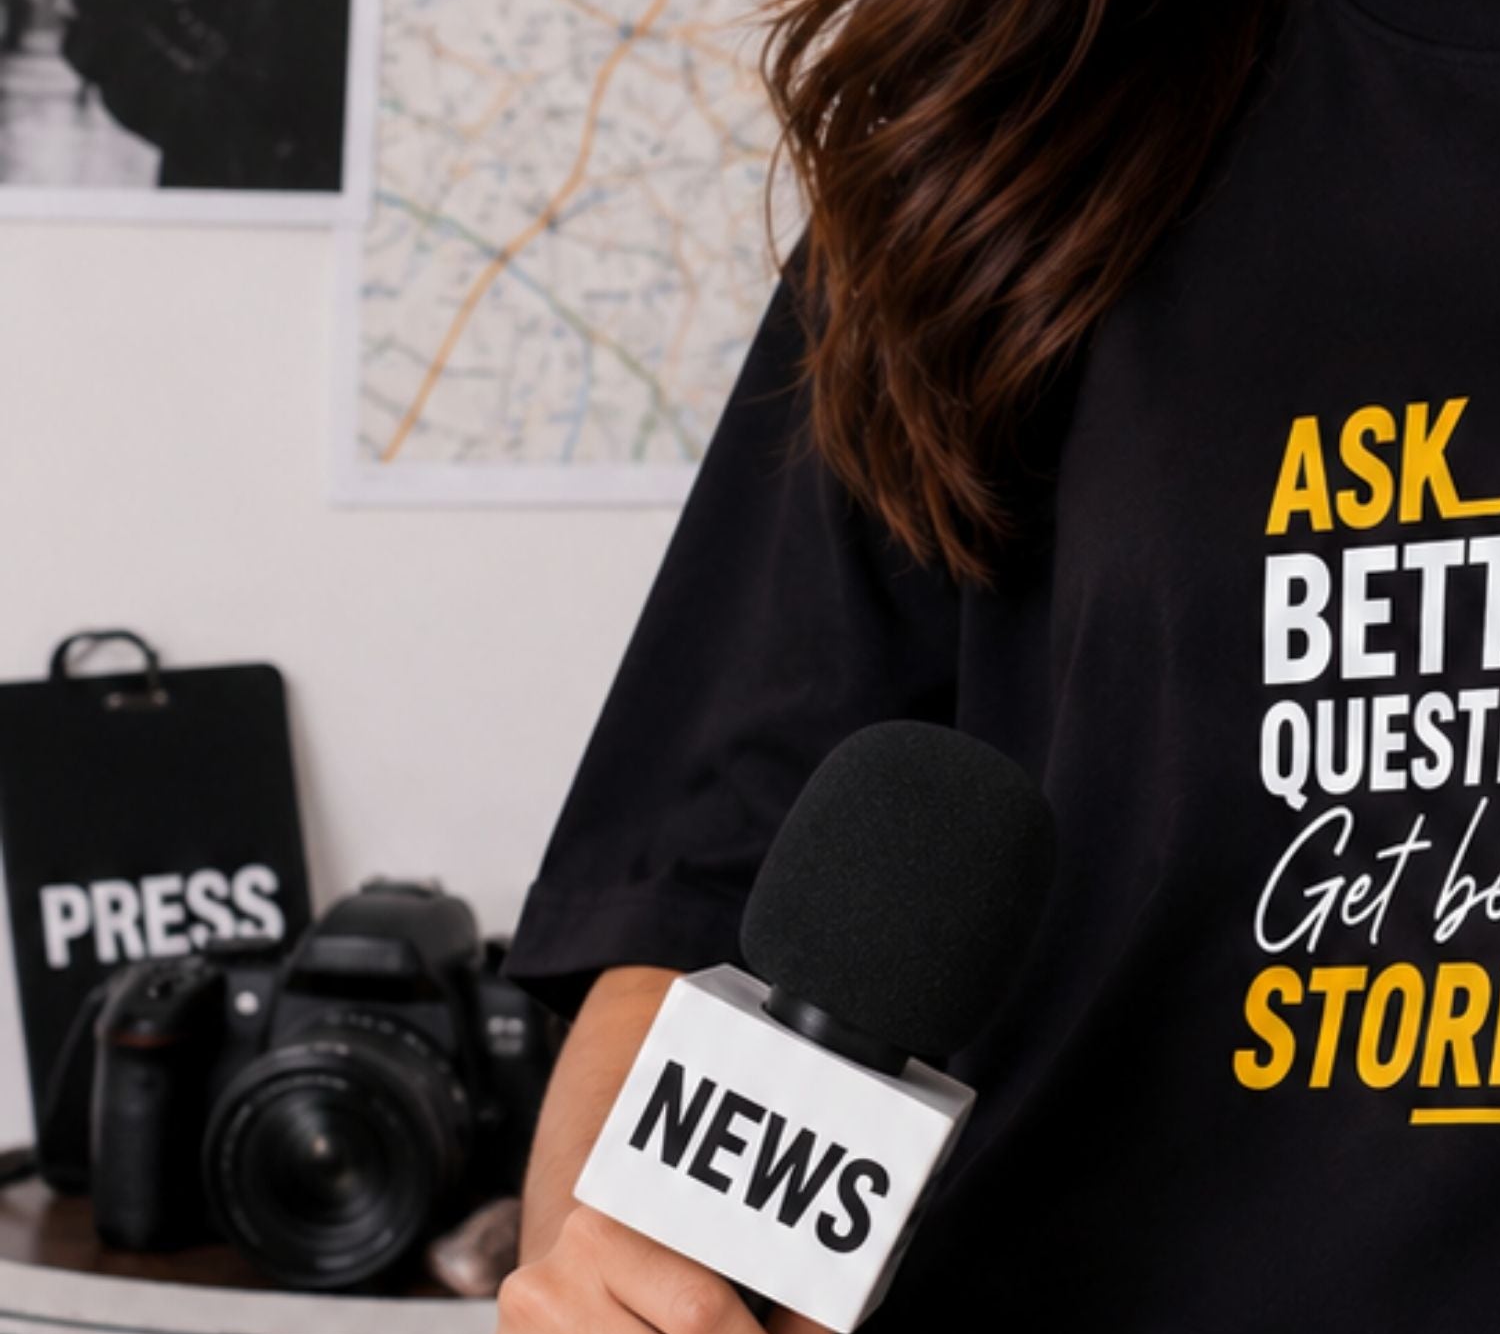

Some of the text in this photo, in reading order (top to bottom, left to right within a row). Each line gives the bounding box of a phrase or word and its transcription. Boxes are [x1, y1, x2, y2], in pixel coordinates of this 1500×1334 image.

[1265, 397, 1468, 535] ASK
[40, 864, 286, 968] PRESS
[1253, 805, 1432, 953] Get
[628, 1059, 890, 1254] NEWS
